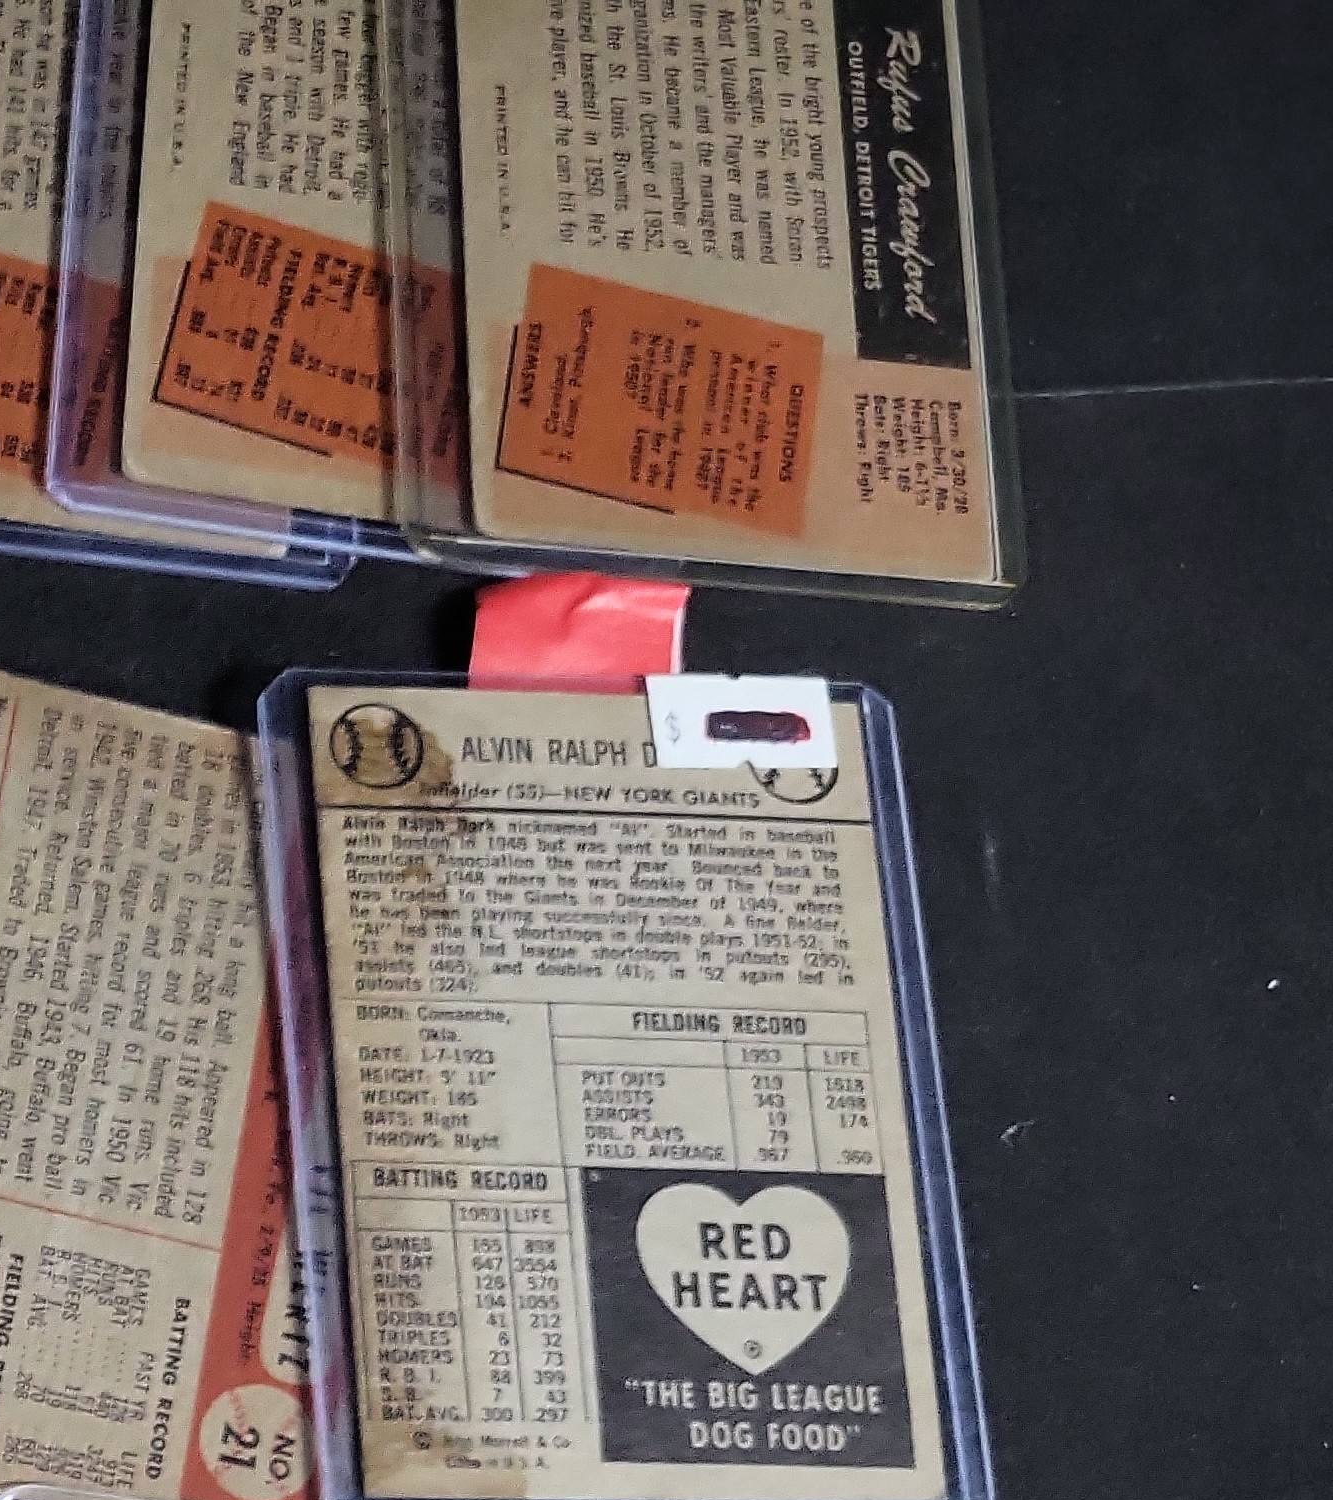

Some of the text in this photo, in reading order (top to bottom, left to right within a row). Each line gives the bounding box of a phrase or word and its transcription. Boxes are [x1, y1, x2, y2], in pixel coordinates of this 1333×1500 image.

[849, 41, 883, 290] OUTFIELD, DETROIT TIGERS
[877, 28, 935, 324] Rufus Crawford
[665, 714, 680, 744] $
[461, 736, 532, 762] ALVIN
[548, 739, 626, 765] RALPH
[632, 1012, 806, 1036] FIELDING RECORD
[373, 1167, 548, 1191] BATTING RECORD
[700, 1222, 791, 1260] RED
[672, 1270, 827, 1312] HEART
[147, 1298, 191, 1480] BATTING RECORD
[707, 1382, 756, 1410] BIG
[772, 1384, 881, 1413] LEAGUE
[218, 1422, 261, 1471] 21
[689, 1423, 753, 1450] DOG
